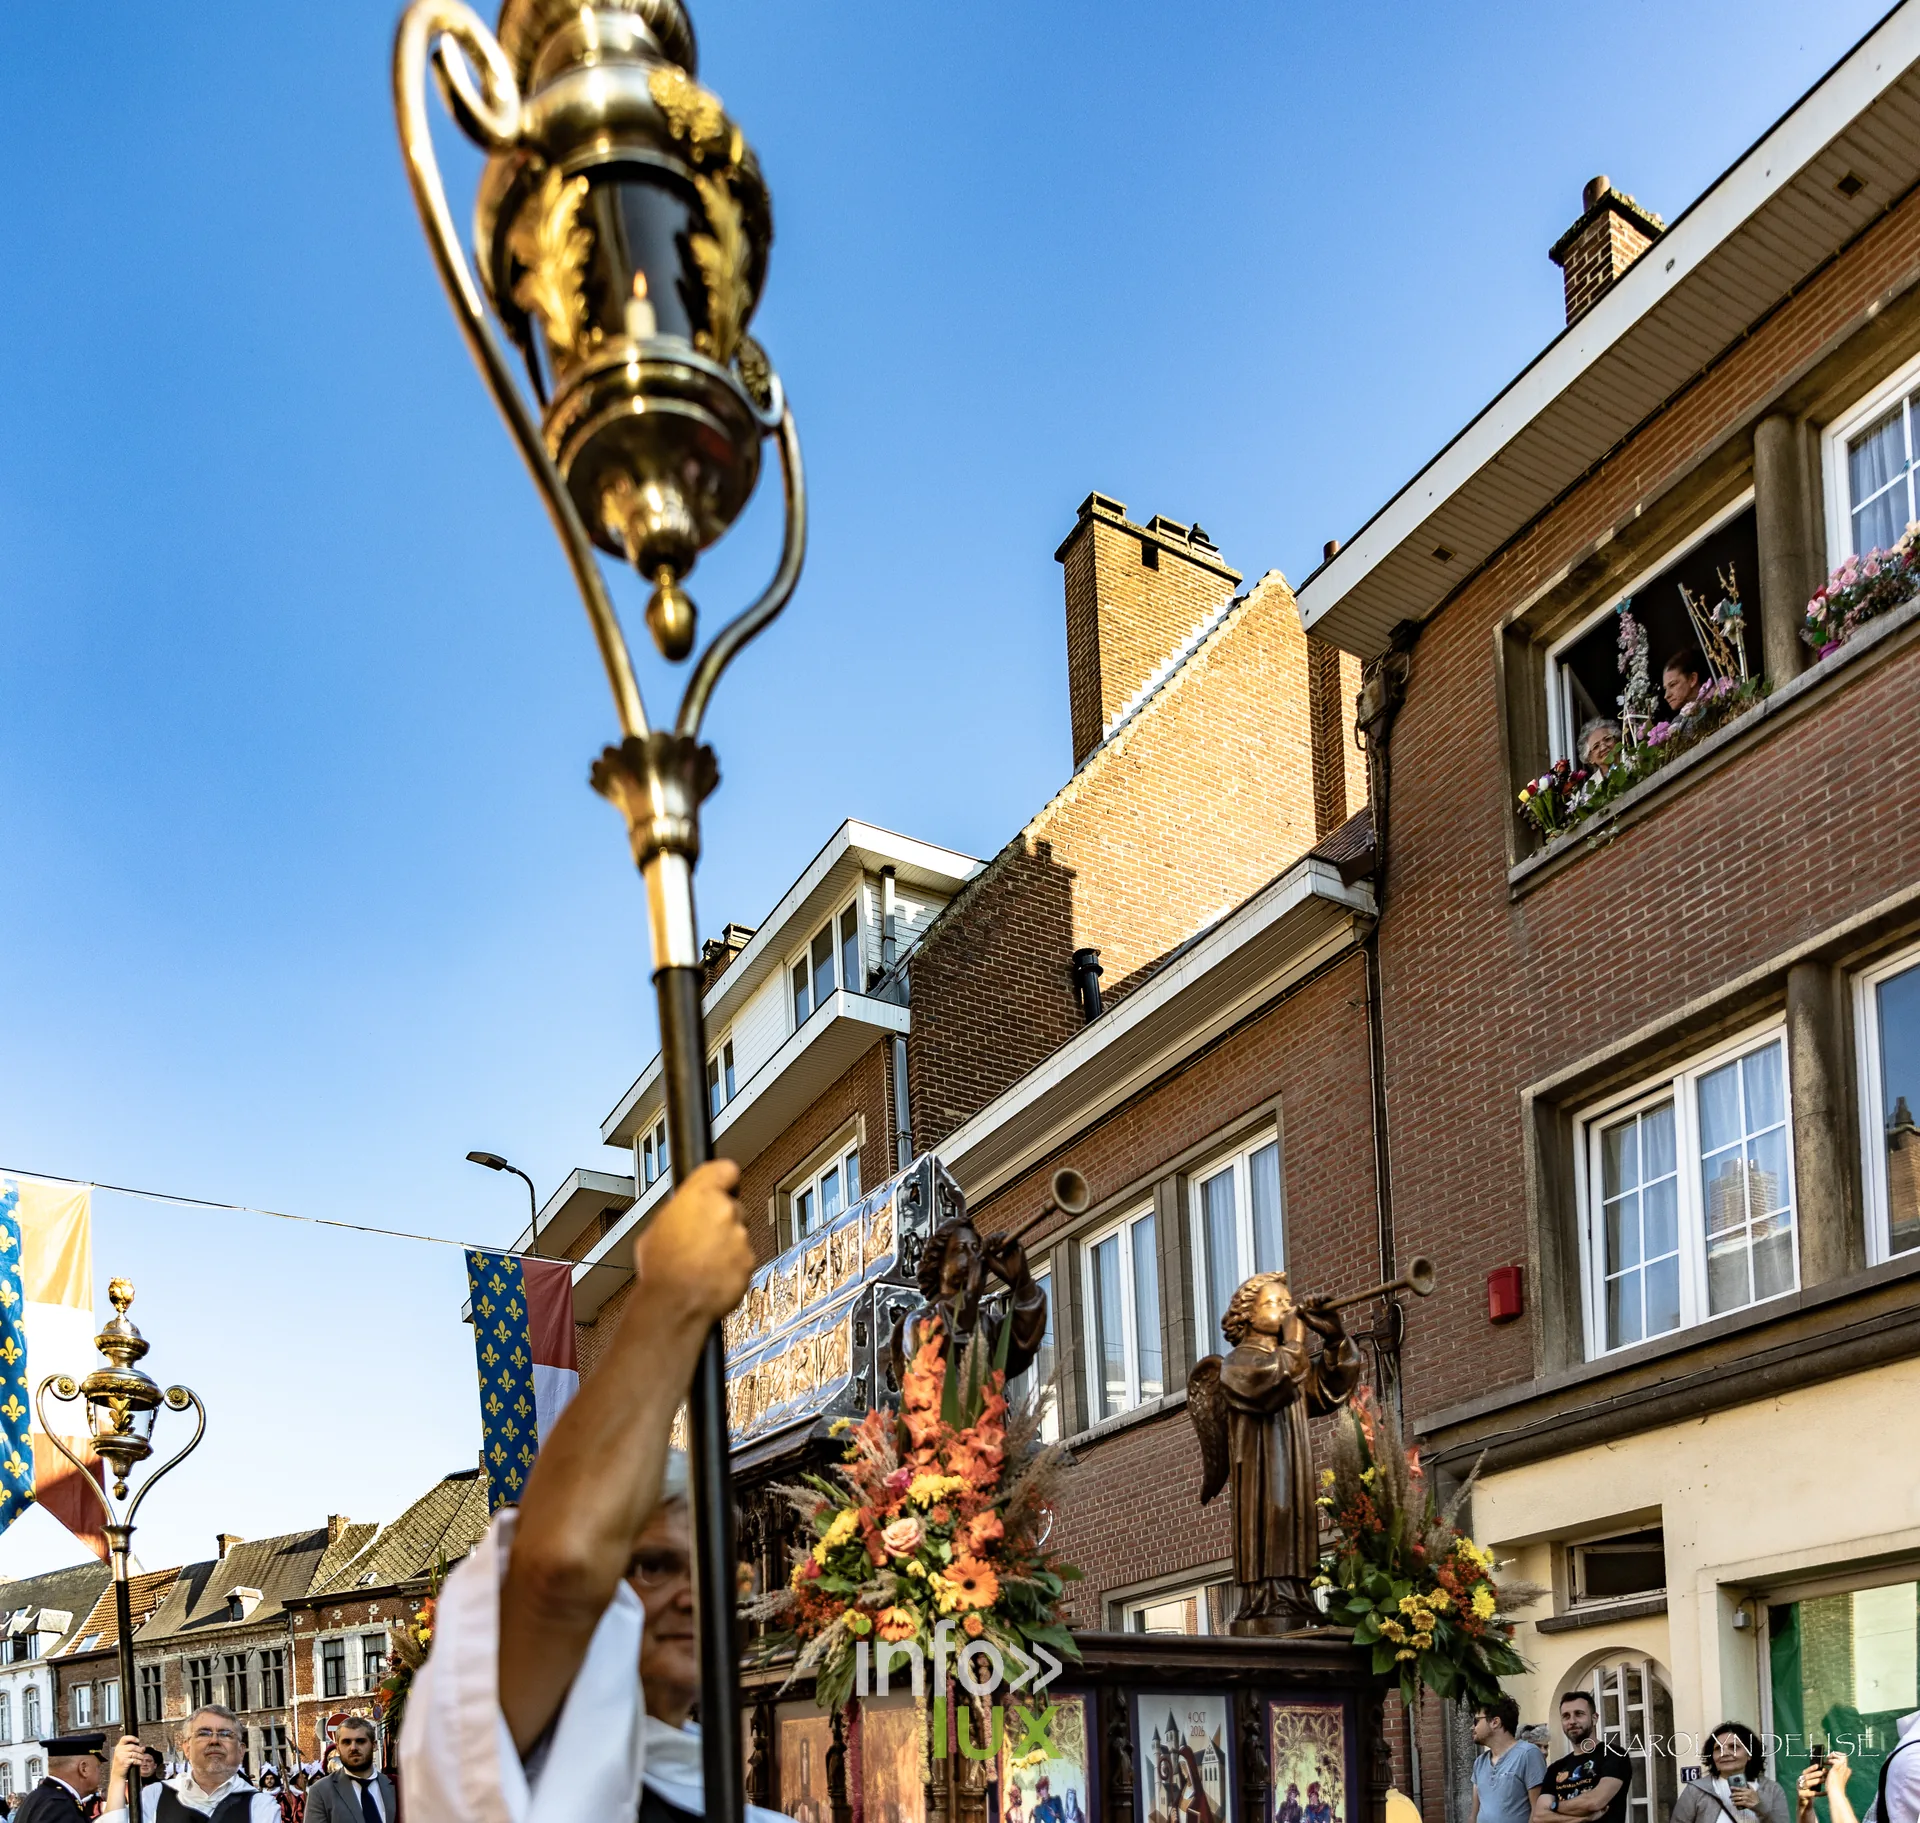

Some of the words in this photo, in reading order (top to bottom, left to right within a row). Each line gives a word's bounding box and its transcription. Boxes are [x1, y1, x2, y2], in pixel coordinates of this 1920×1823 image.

[1192, 1711, 1206, 1723] OCT
[1190, 1725, 1205, 1737] 2026
[1685, 1768, 1698, 1781] 16
